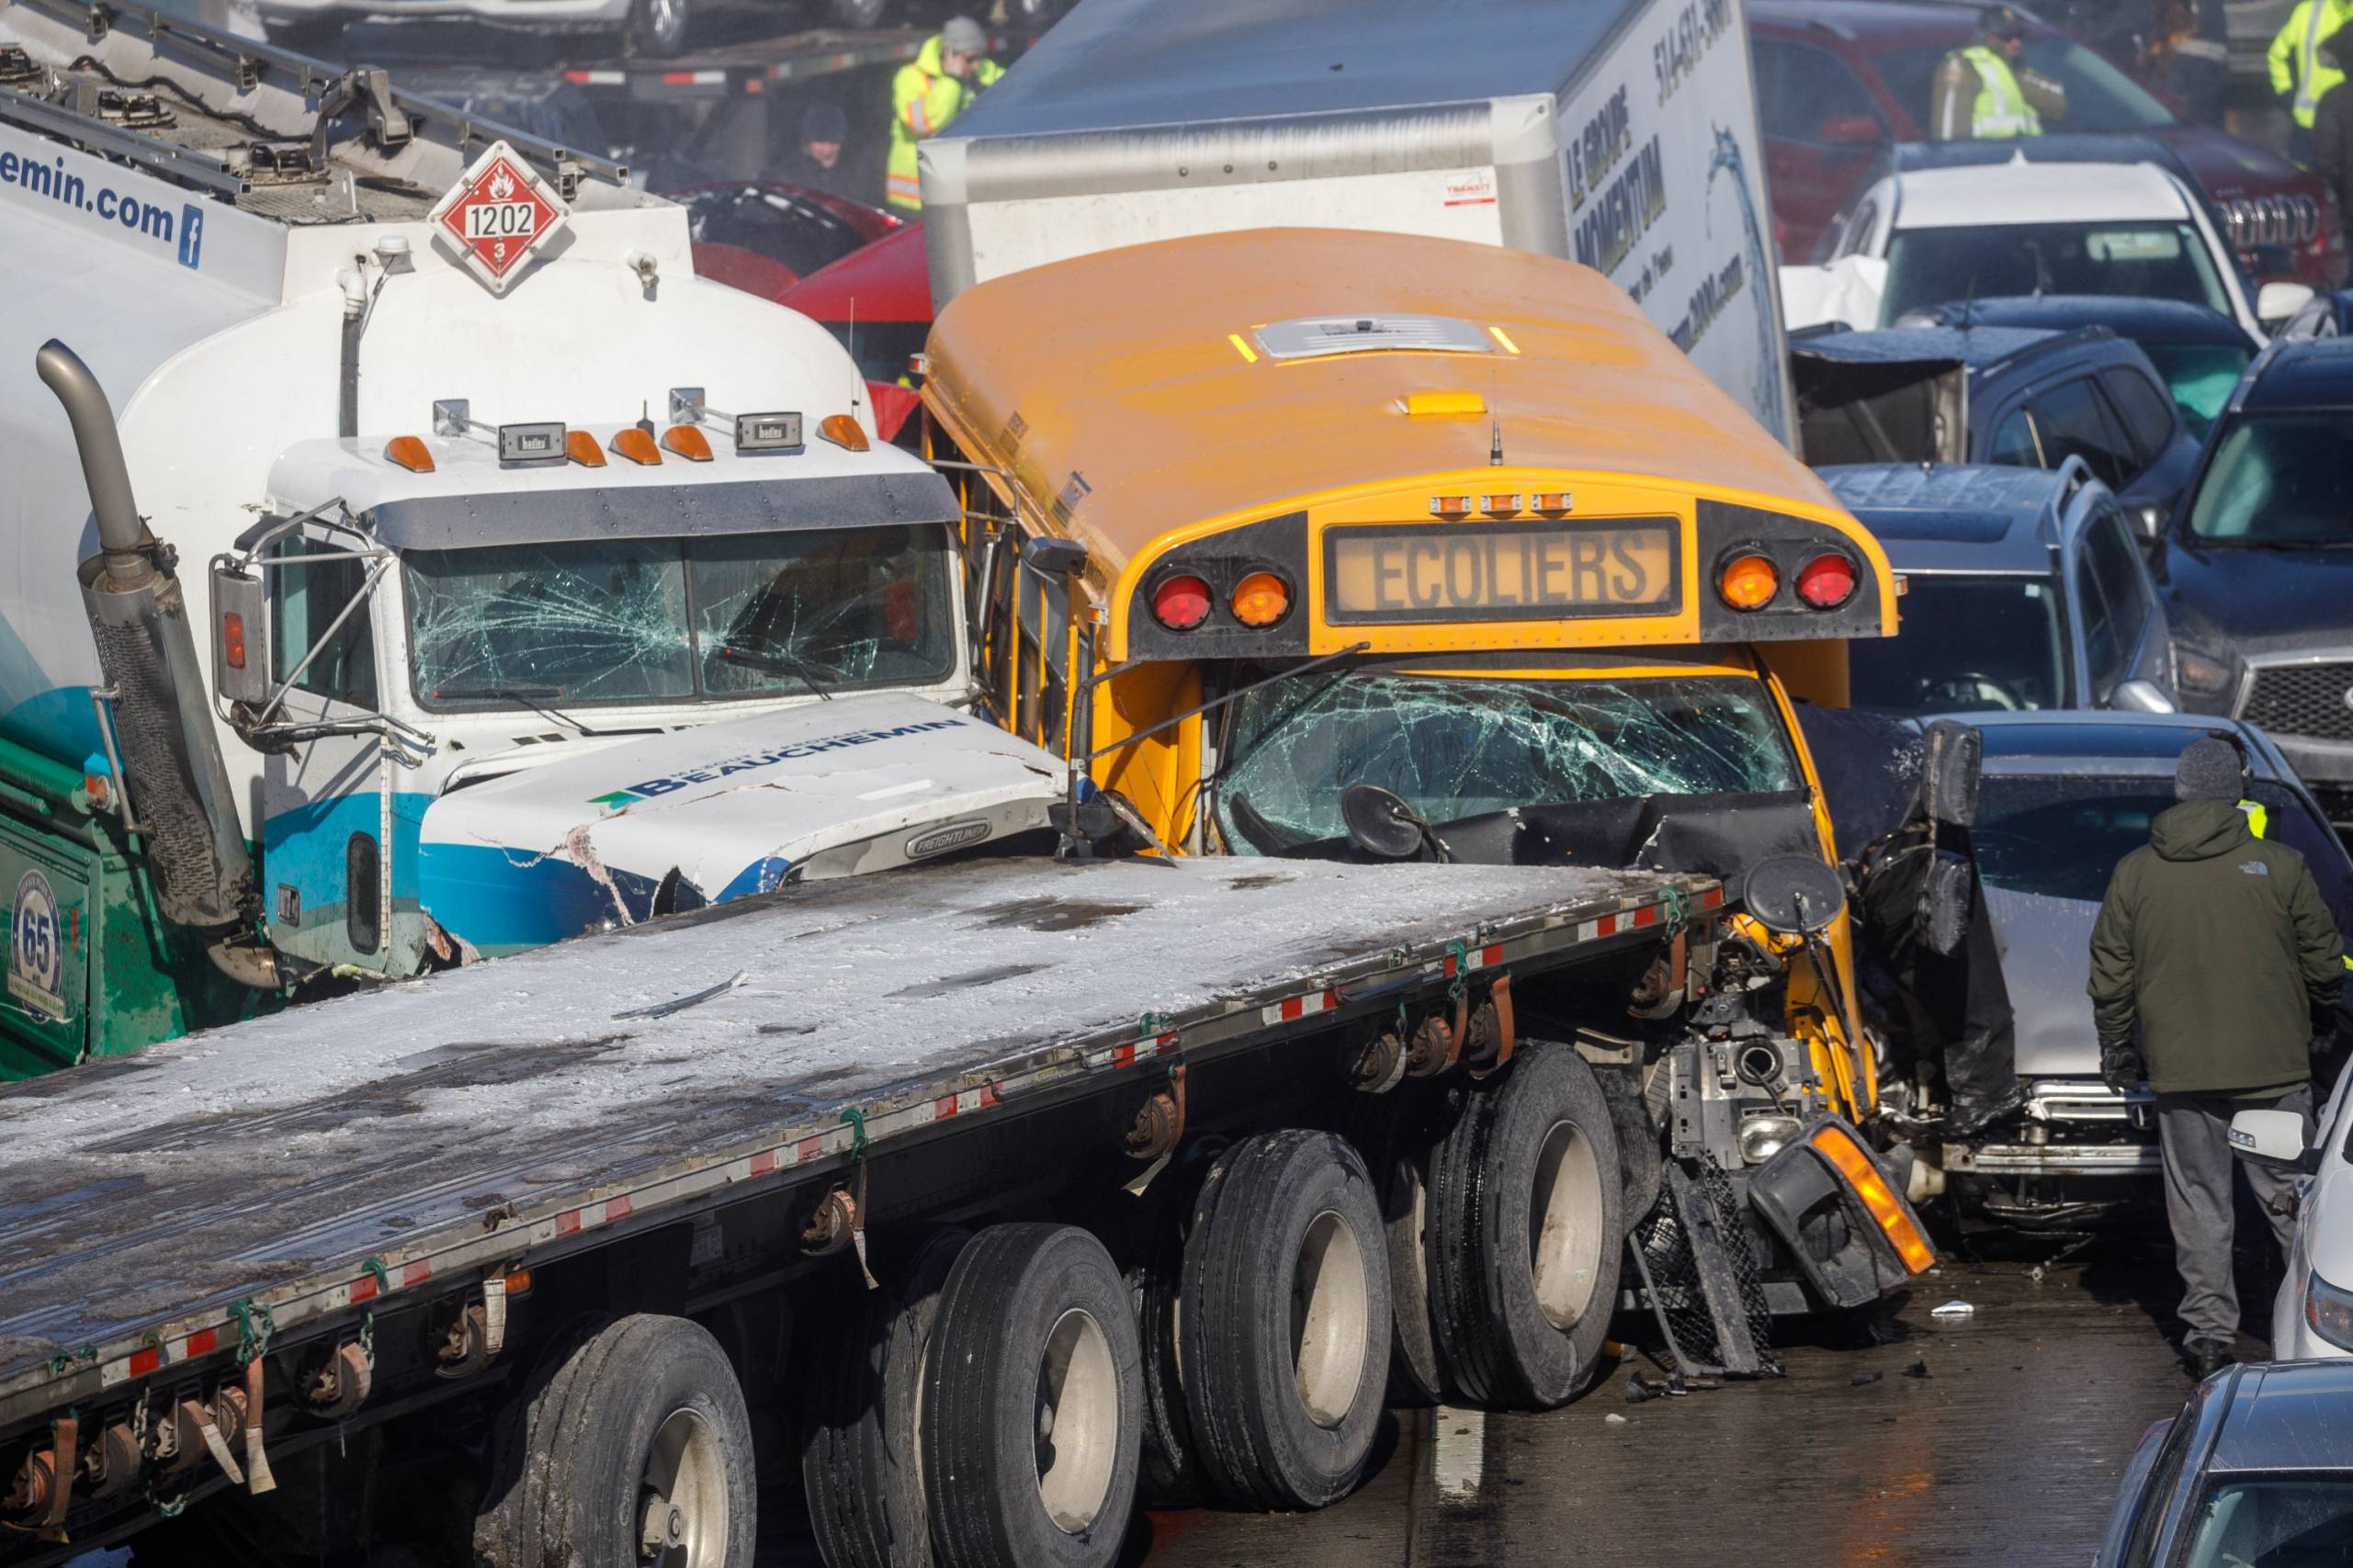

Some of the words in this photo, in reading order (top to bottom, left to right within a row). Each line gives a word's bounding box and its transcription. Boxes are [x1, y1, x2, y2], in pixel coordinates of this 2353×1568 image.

[0, 152, 174, 243] emin.com
[470, 204, 533, 236] 1202
[493, 243, 505, 258] 3
[1373, 529, 1647, 609] ECOLIERS
[627, 719, 969, 797] BEAUCHEMIN
[917, 825, 986, 852] FREIGHTLINER
[22, 907, 50, 975] 65
